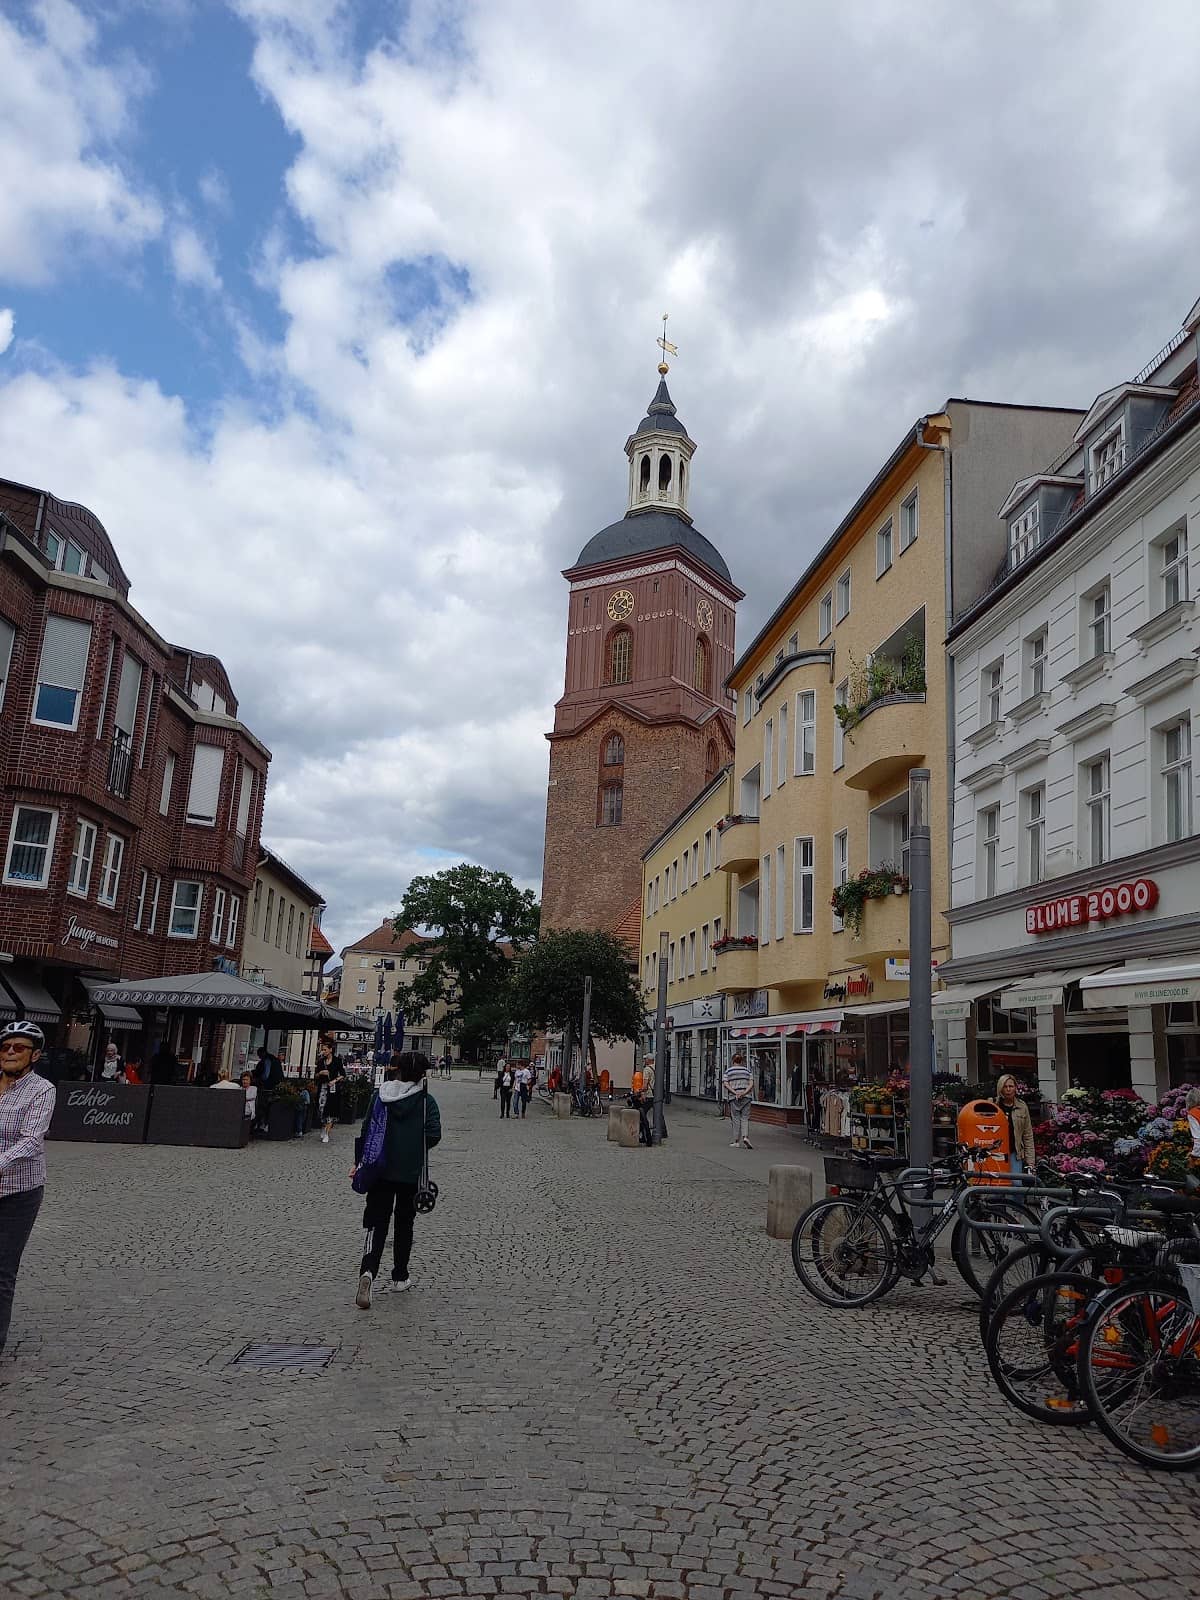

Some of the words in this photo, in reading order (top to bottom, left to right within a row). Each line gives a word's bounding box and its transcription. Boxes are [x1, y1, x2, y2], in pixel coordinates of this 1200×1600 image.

[1025, 898, 1082, 932] BLUME
[1087, 881, 1150, 918] 2000
[61, 914, 97, 951] Junge
[67, 1087, 116, 1107] Echter
[82, 1108, 134, 1126] Genuss
